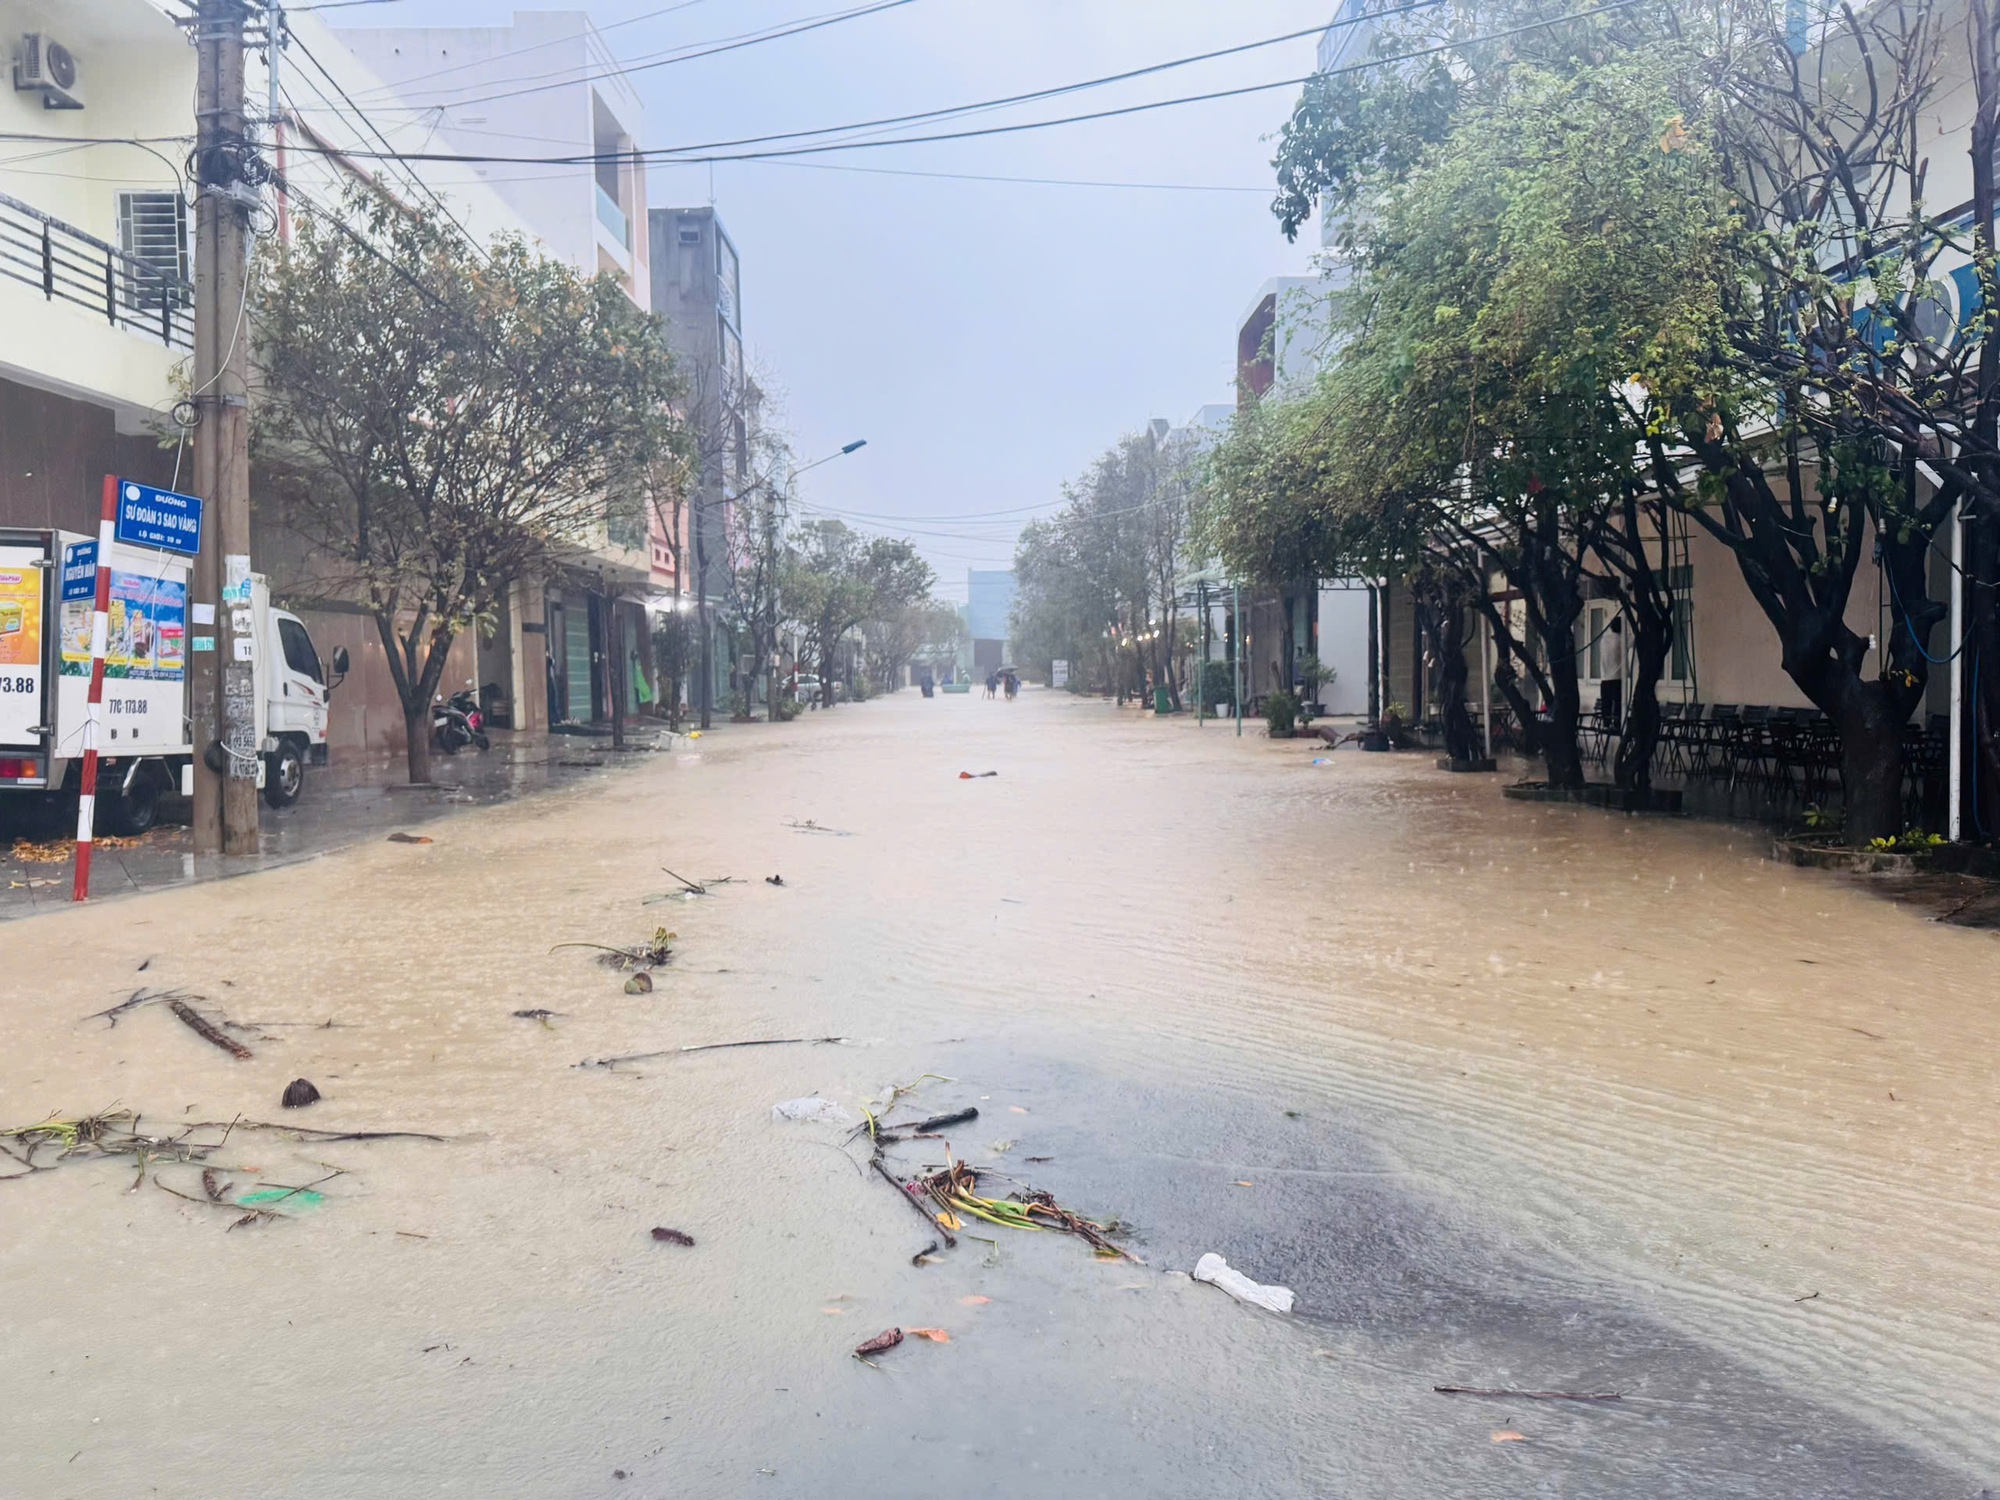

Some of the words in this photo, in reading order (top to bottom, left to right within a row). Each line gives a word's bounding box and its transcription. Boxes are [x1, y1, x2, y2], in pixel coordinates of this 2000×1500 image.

[136, 505, 157, 525] ĐOÀN
[157, 511, 162, 526] 3
[163, 512, 177, 529] SAO
[178, 513, 197, 533] VÀNG
